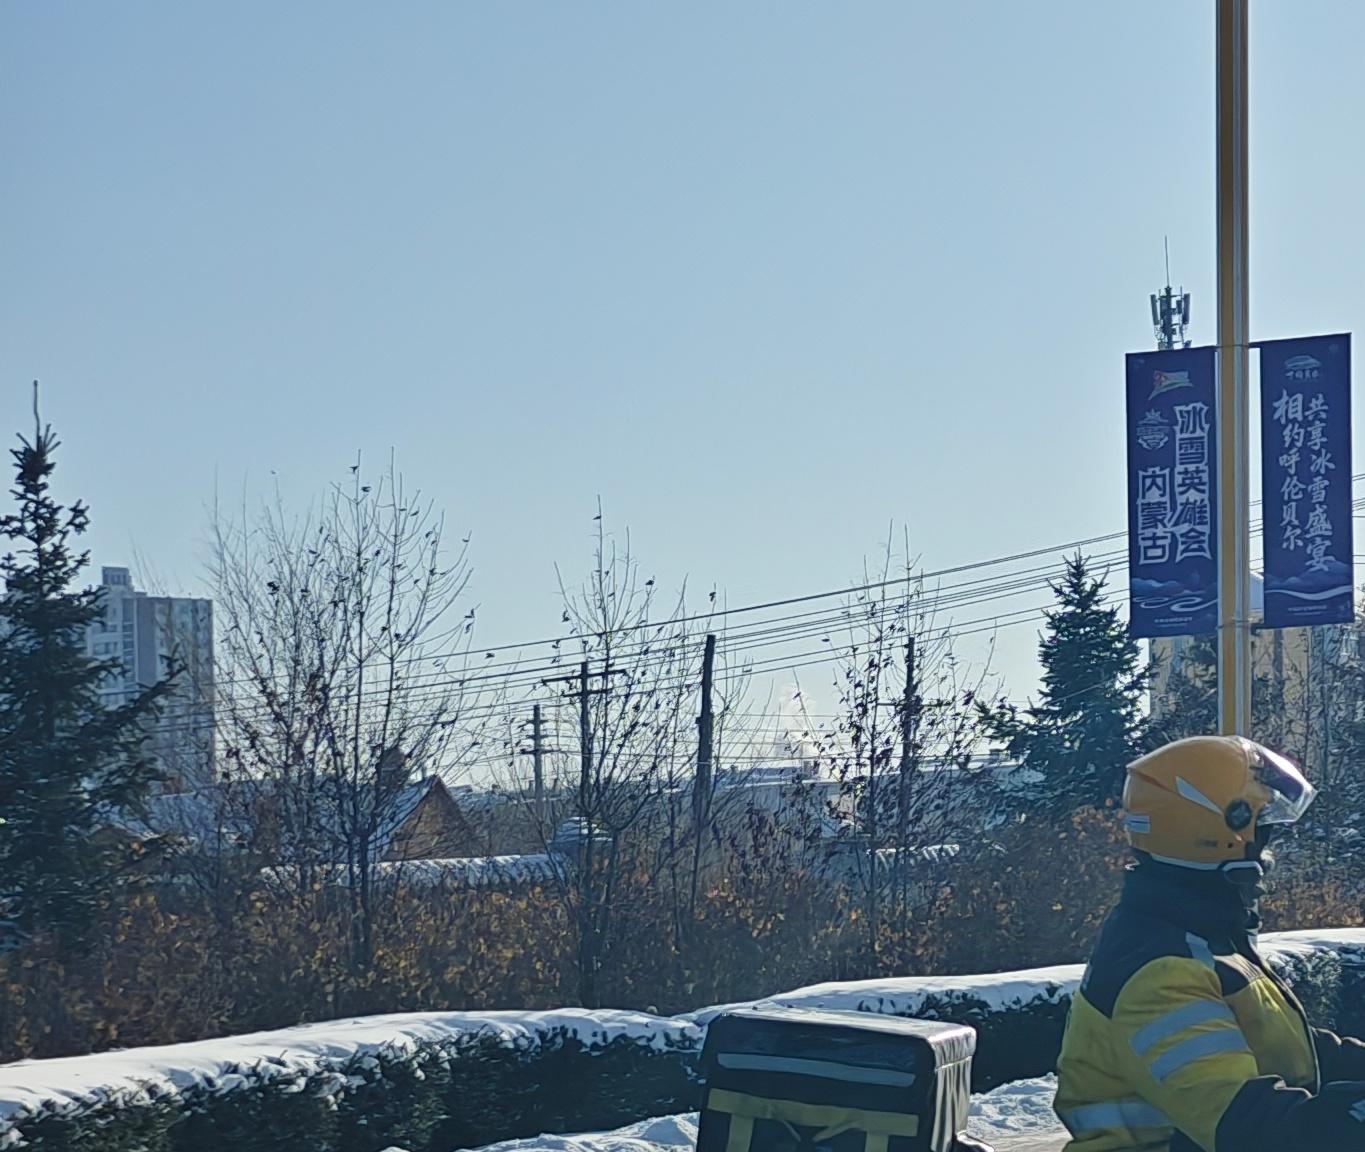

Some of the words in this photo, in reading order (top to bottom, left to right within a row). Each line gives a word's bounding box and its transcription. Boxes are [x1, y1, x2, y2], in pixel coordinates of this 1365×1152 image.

[1137, 468, 1170, 563] 内蒙古
[1174, 402, 1211, 562] 冰雪英雄会
[1273, 389, 1305, 550] 相约呼伦贝尔
[1304, 394, 1335, 571] 共享冰雪盛宴
